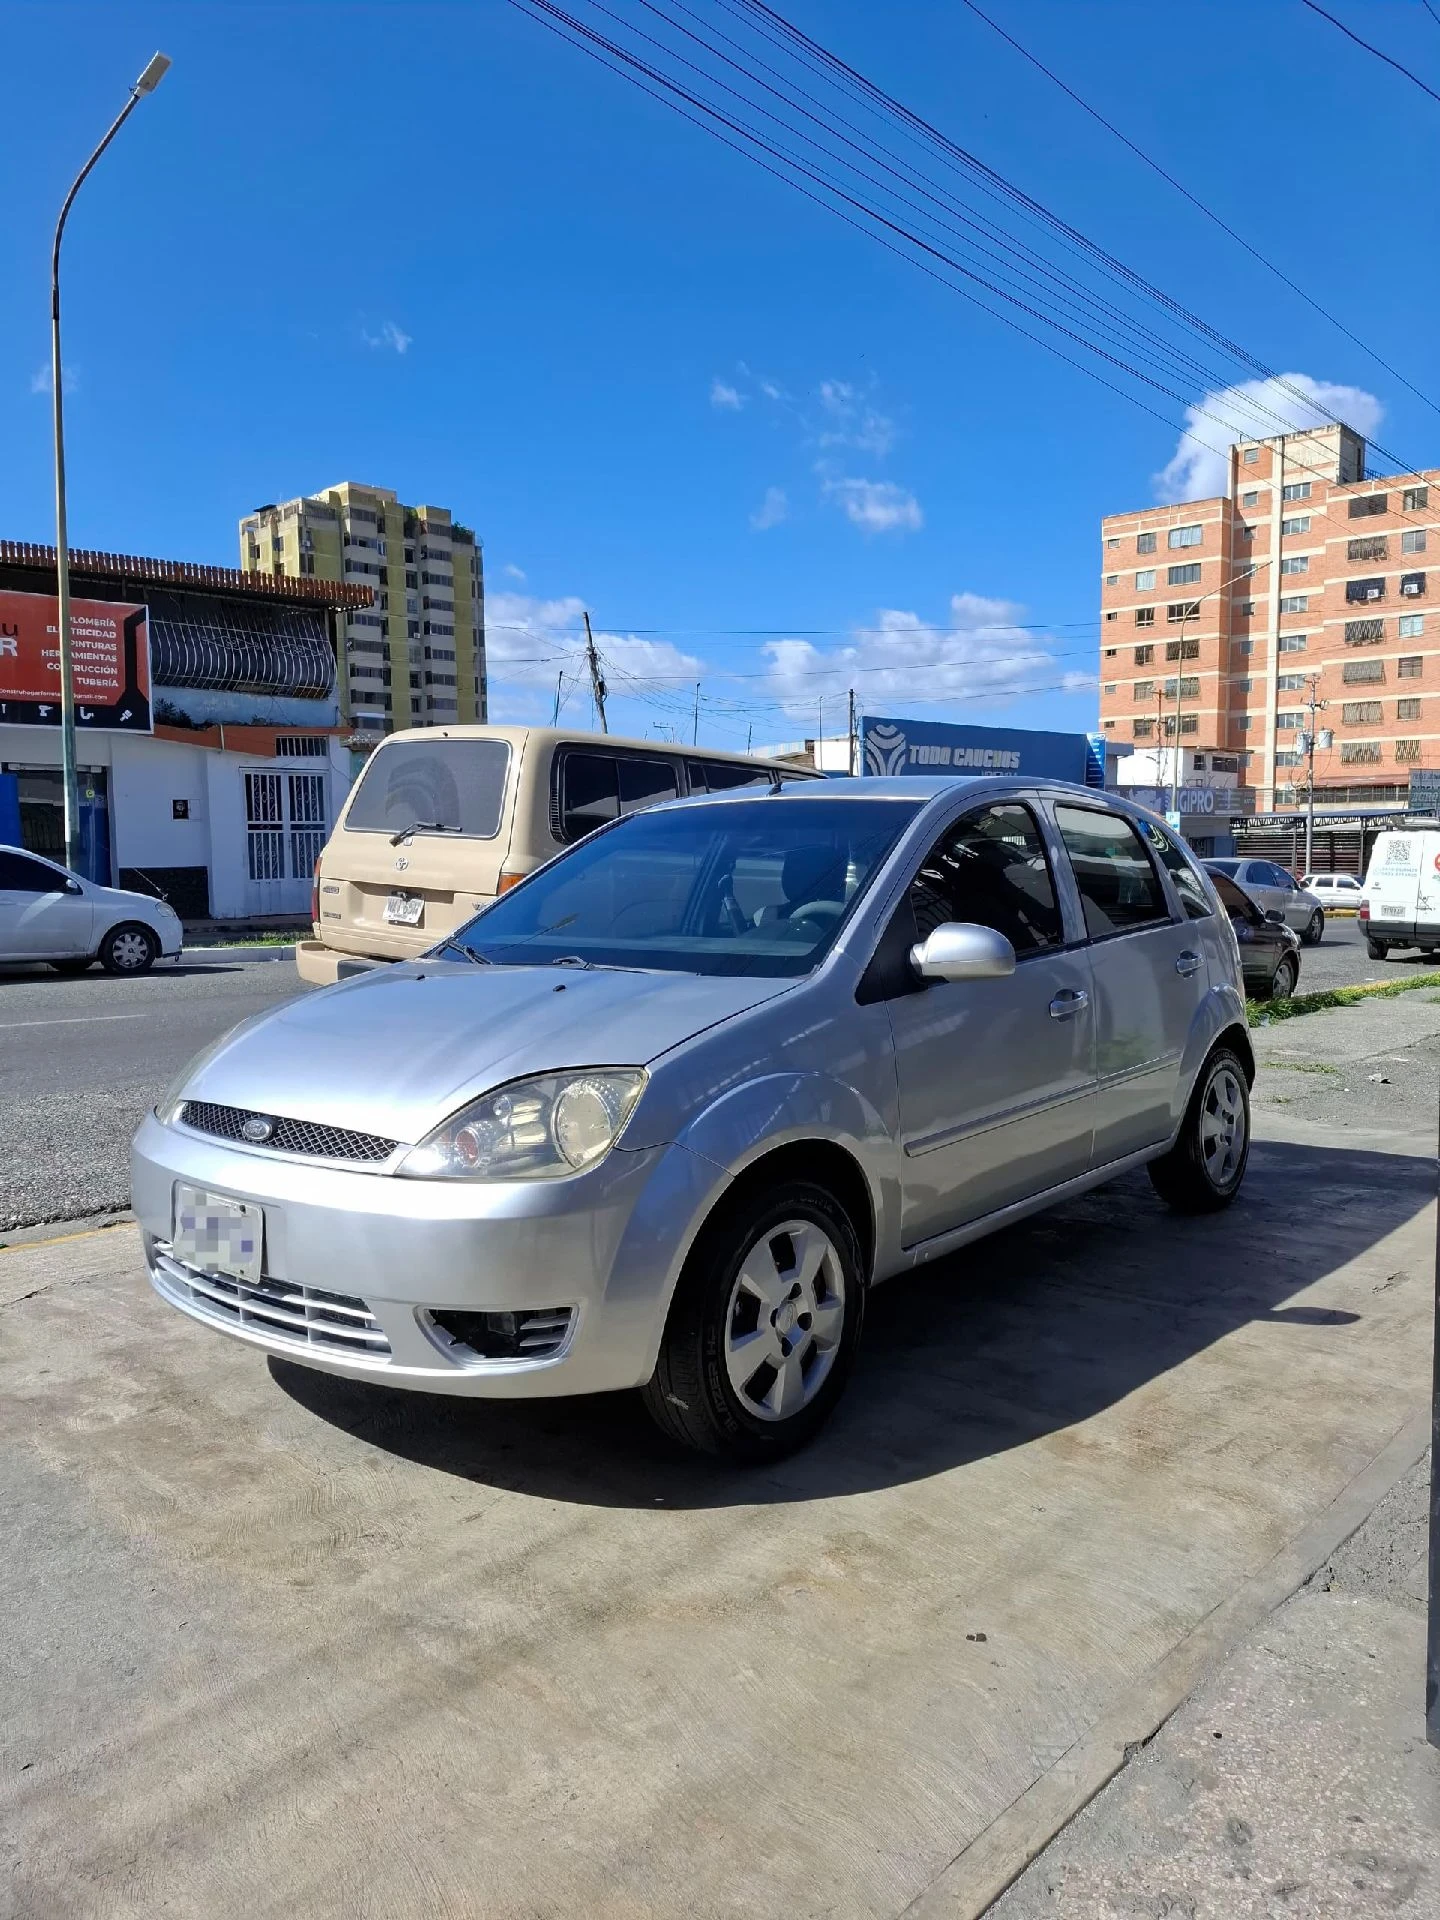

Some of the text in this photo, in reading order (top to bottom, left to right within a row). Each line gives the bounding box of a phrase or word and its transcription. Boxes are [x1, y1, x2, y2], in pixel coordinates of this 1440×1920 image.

[46, 625, 117, 638] ELTRICIDAD
[41, 649, 117, 662] HERMIENTAS
[46, 662, 118, 674] COTRUCCIÓN
[77, 677, 119, 687] TUBERÍA
[909, 745, 1020, 768] TODO CAUCHOS
